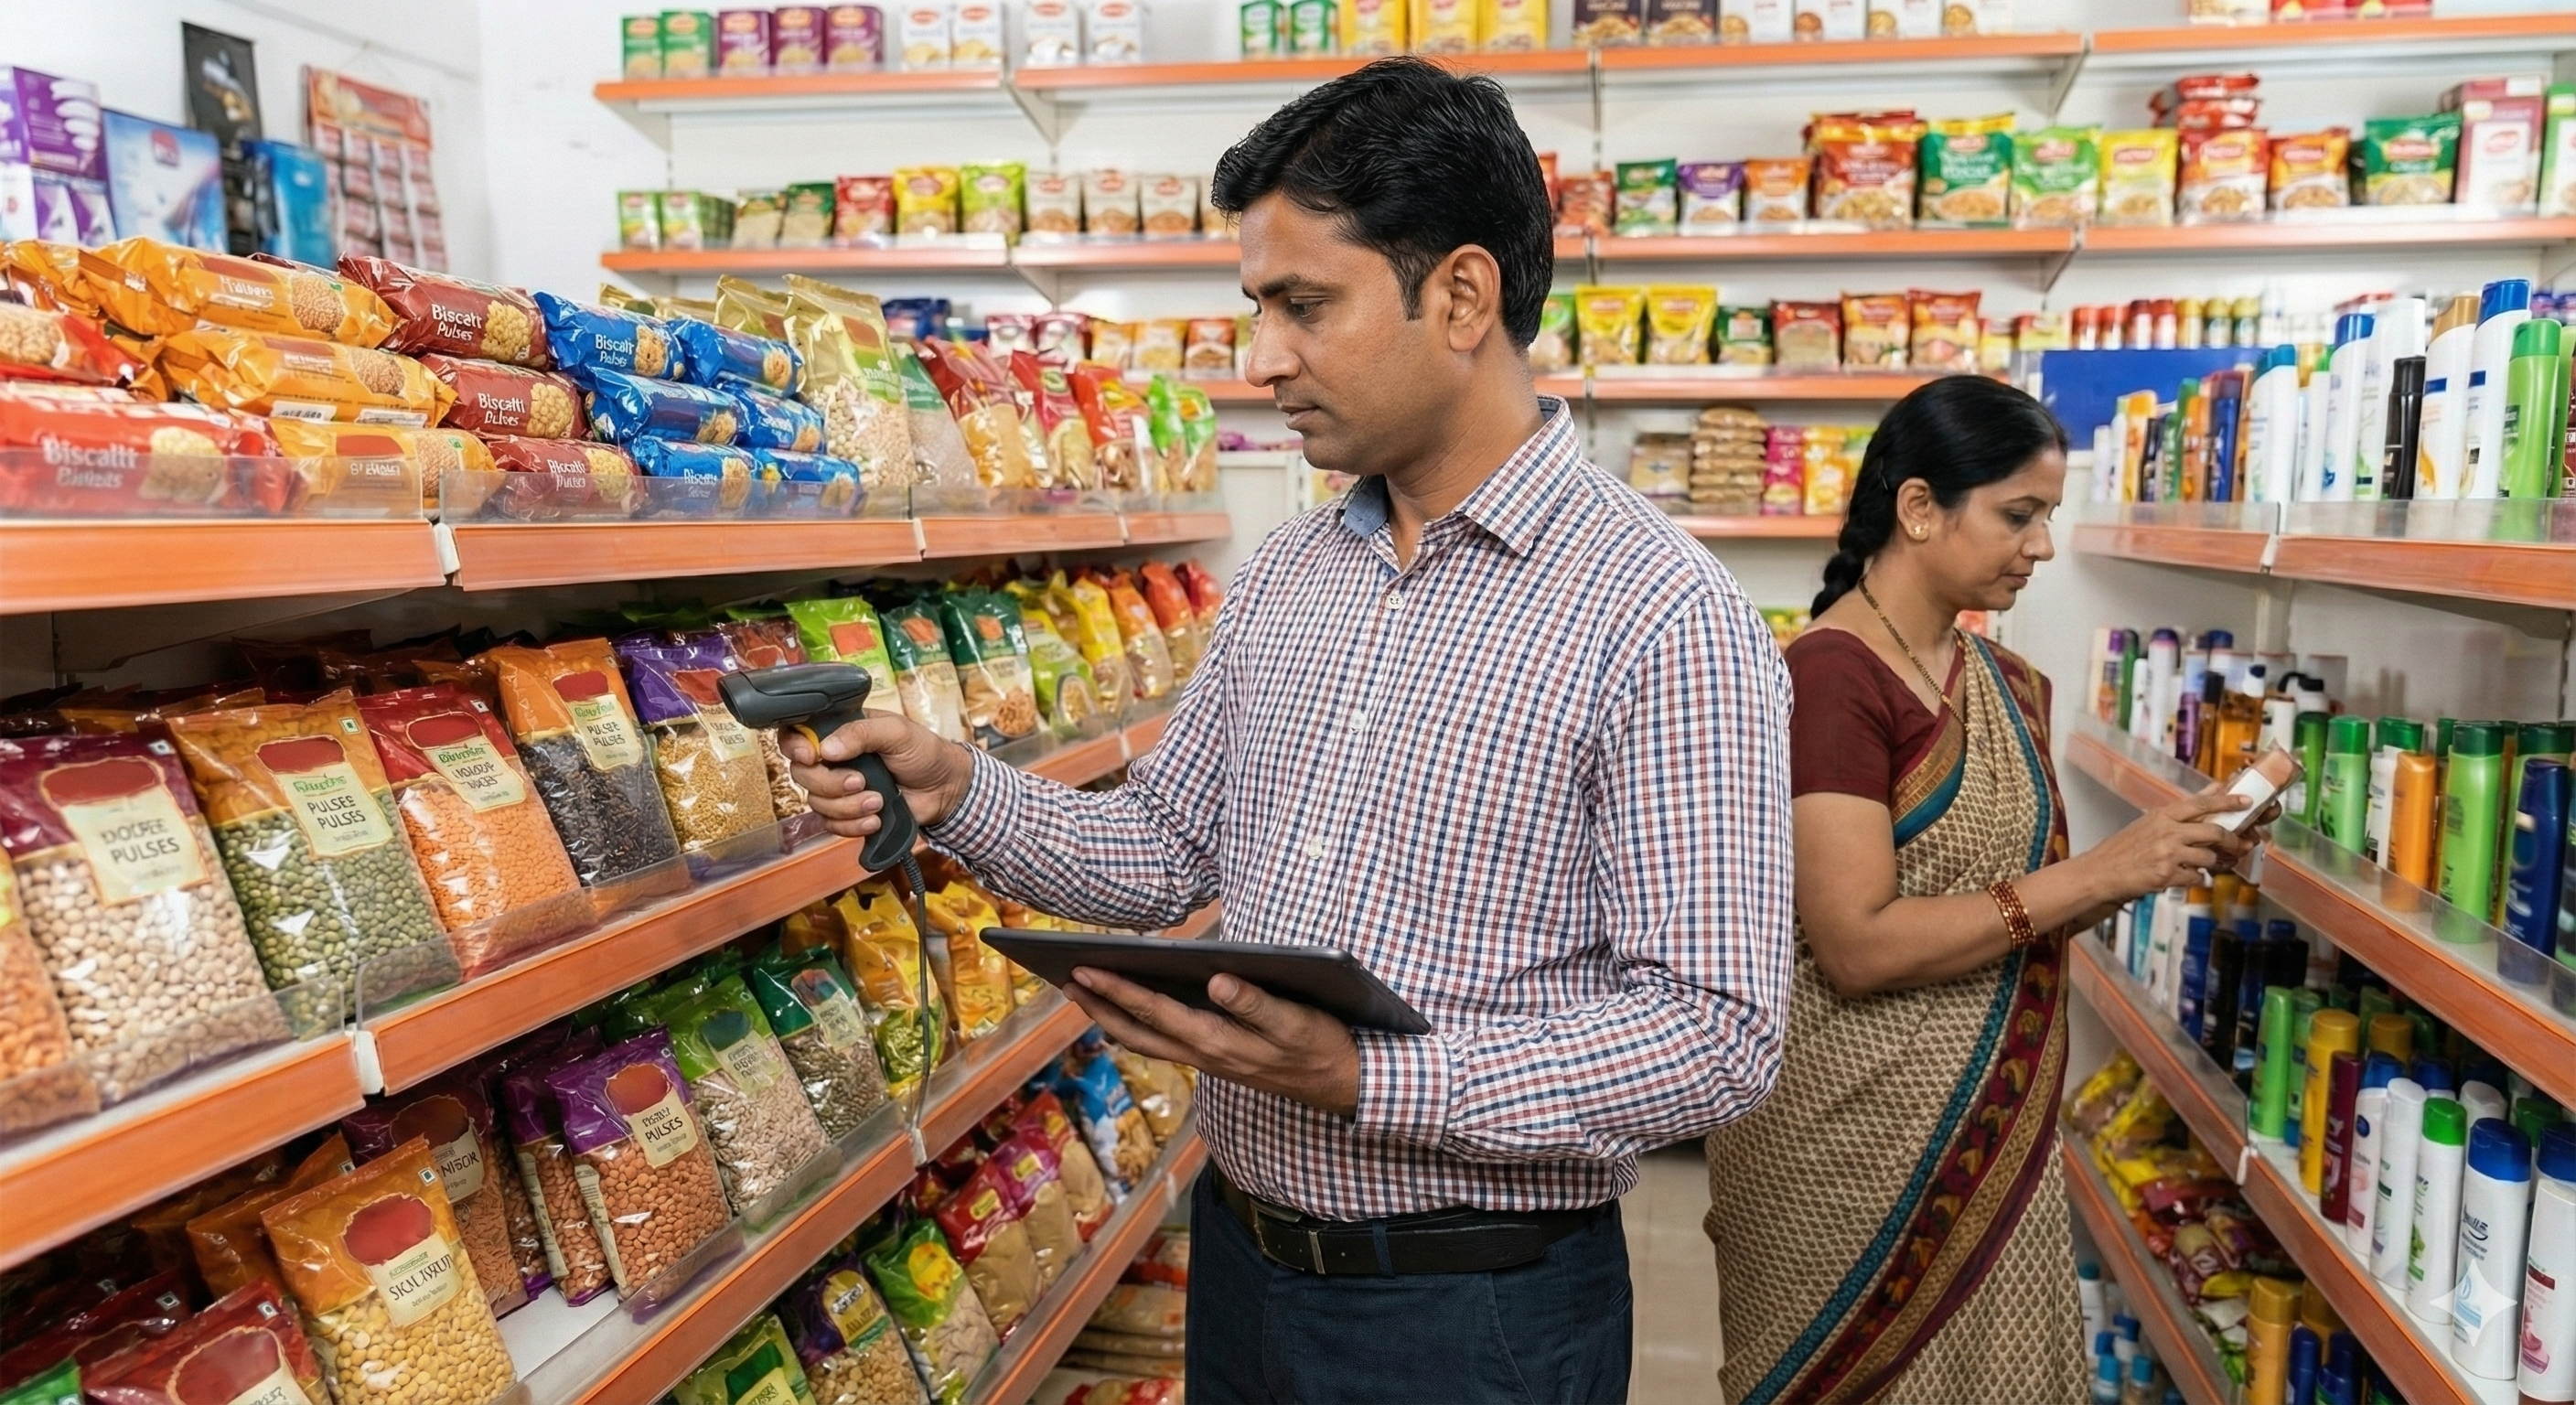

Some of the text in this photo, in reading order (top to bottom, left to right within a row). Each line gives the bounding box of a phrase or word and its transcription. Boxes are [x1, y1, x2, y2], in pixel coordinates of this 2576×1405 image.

[436, 321, 473, 341] Pulses
[317, 810, 366, 830] PULSES
[110, 837, 181, 864] PULSES
[645, 1116, 684, 1143] PULSES
